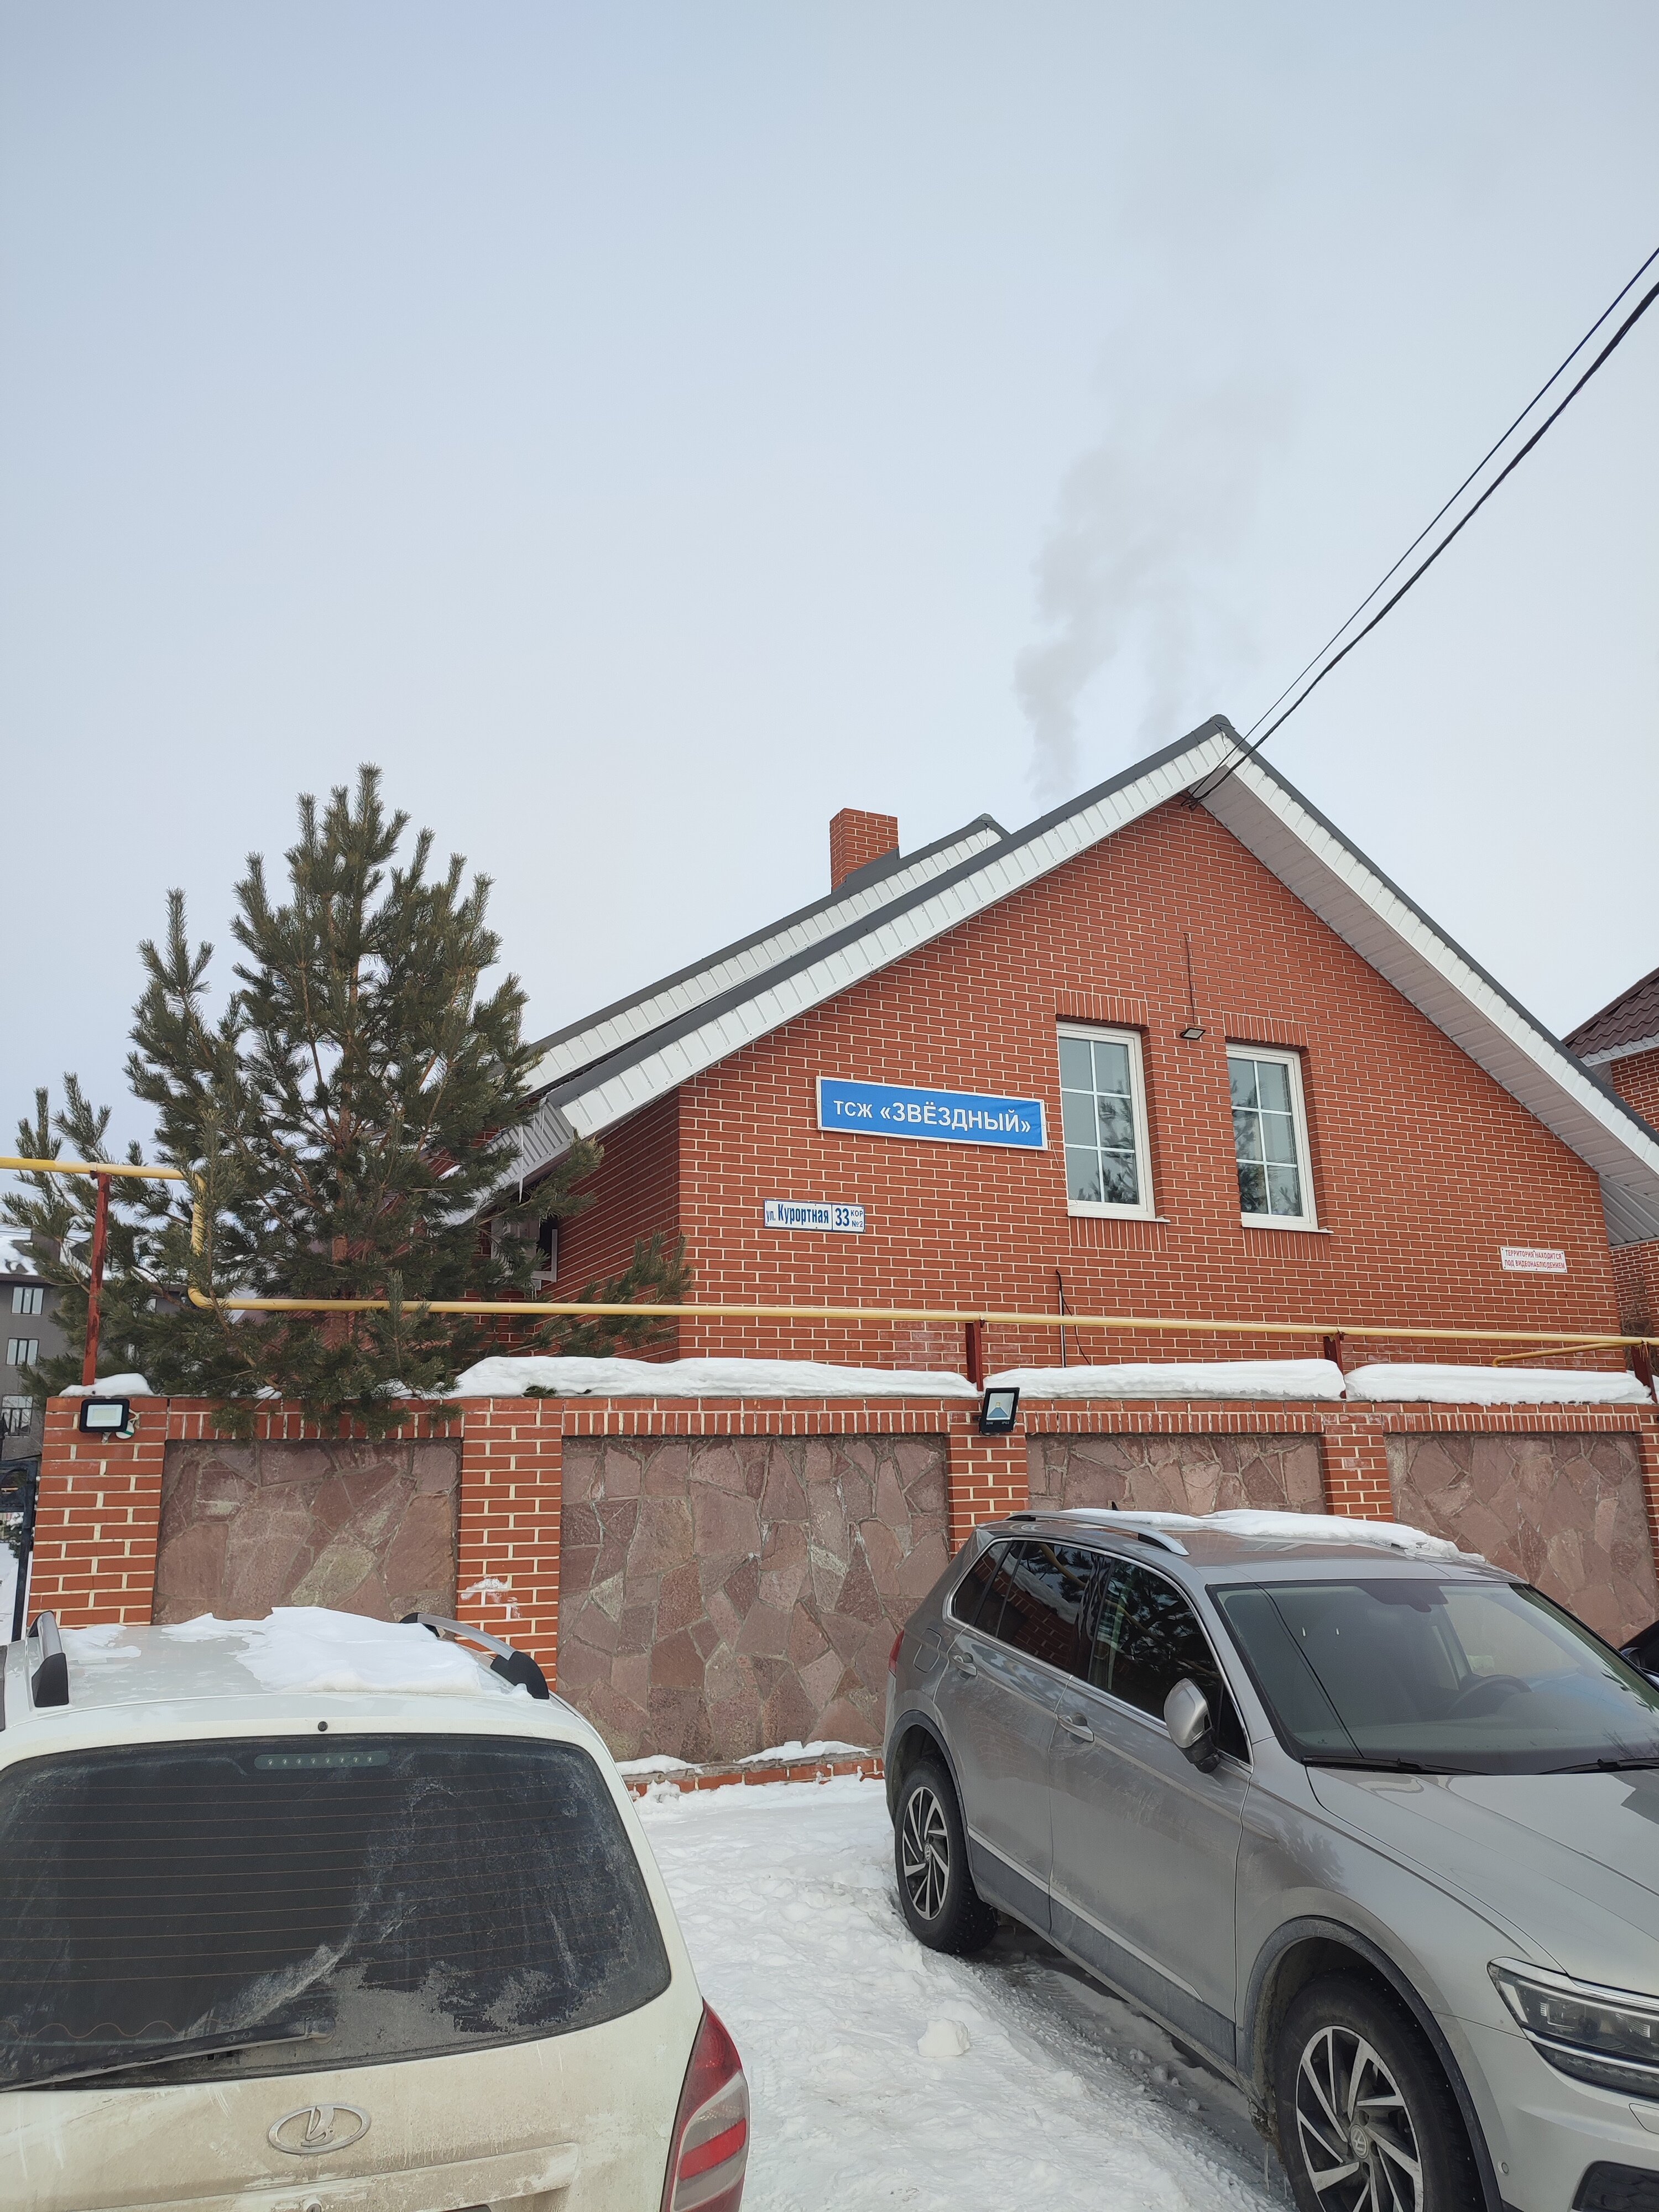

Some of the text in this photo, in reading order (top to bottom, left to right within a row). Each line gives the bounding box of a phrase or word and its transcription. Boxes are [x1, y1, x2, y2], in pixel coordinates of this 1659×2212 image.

[880, 1101, 1031, 1133] «ЗВЁЗДНЫЙ»
[766, 1203, 849, 1227] ул. Курортная 33
[1505, 1250, 1562, 1260] ТЕРРИТОРИЯ НАХОДИТСЯ
[1505, 1260, 1565, 1269] ПОД ВИДЕОНАБЛЮДЕНИЕМ
